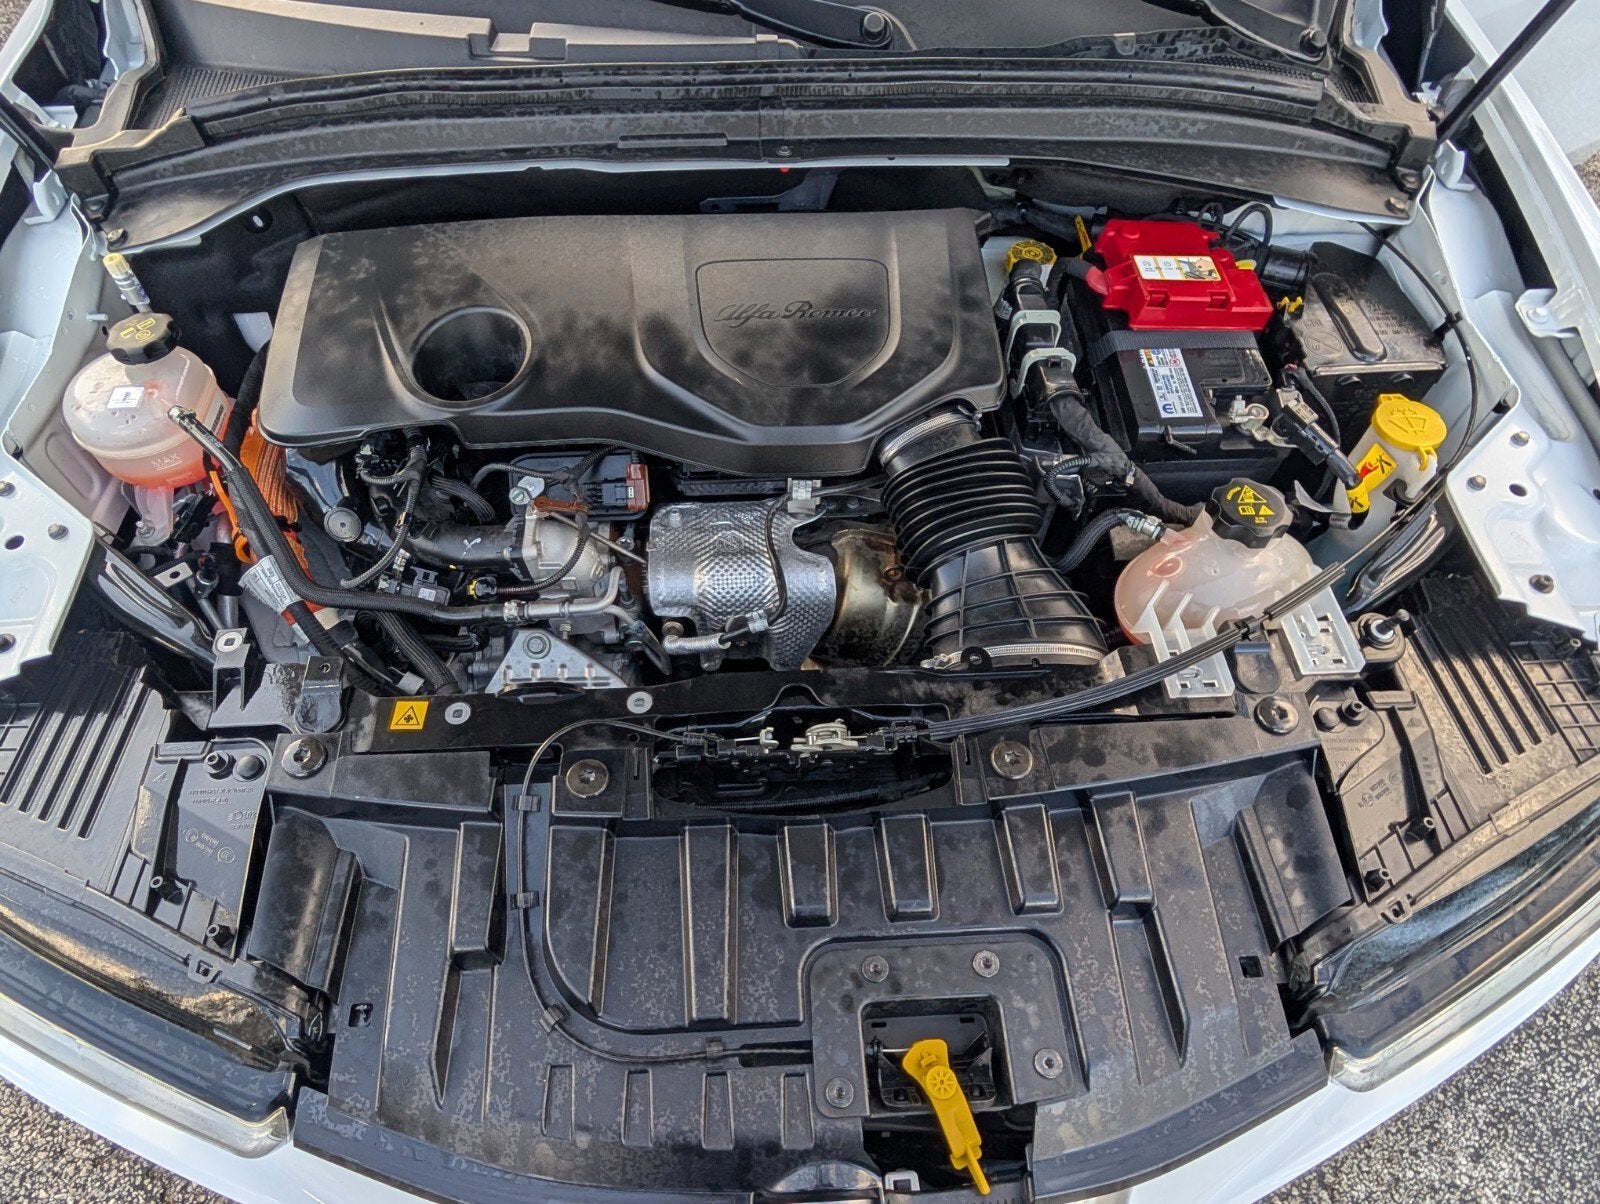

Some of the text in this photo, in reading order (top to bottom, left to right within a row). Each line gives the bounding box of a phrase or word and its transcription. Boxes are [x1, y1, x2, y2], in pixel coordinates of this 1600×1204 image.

[714, 300, 877, 328] Alfa Romeo
[151, 453, 181, 469] MAX
